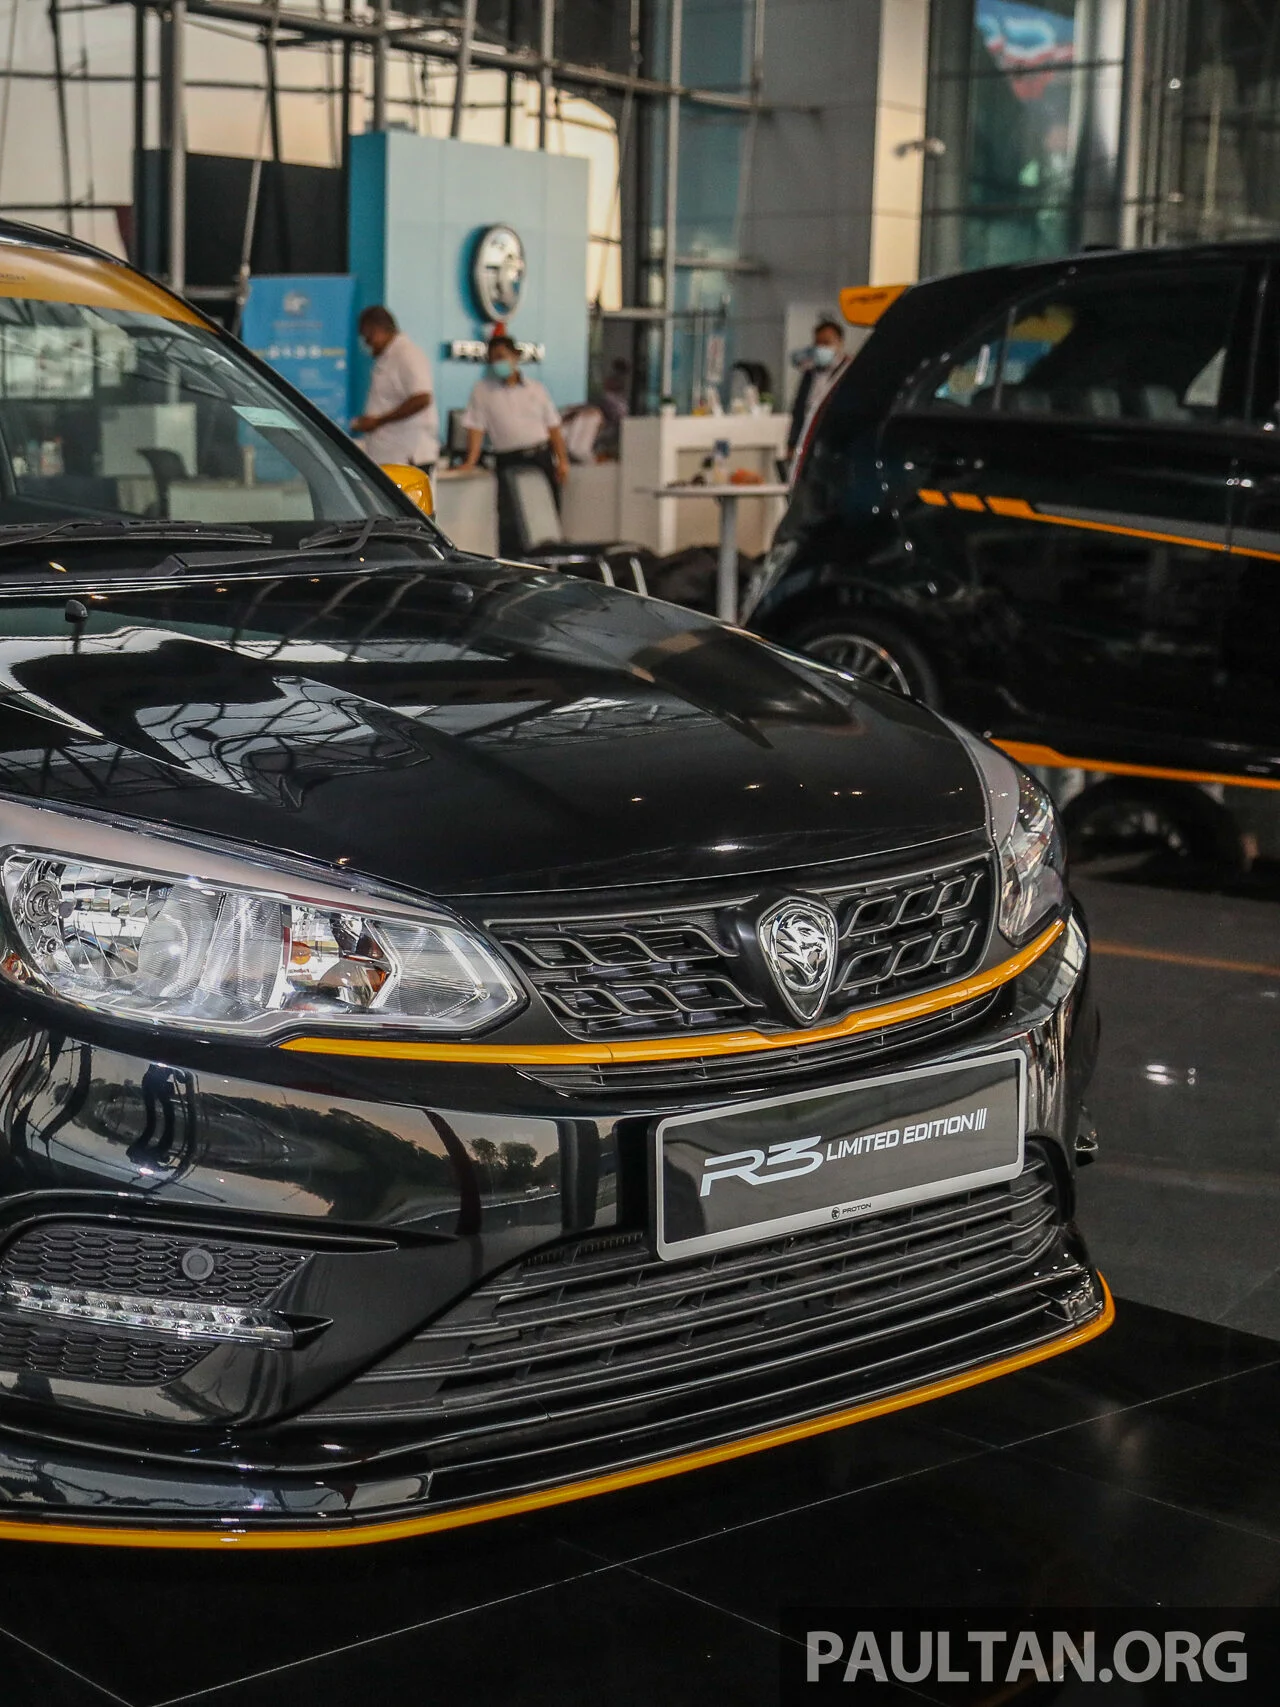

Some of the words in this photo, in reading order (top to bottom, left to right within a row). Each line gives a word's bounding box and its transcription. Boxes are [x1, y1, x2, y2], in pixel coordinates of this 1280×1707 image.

[699, 1135, 824, 1197] R3
[826, 1129, 899, 1161] LIMITED
[842, 1202, 872, 1214] PROTON
